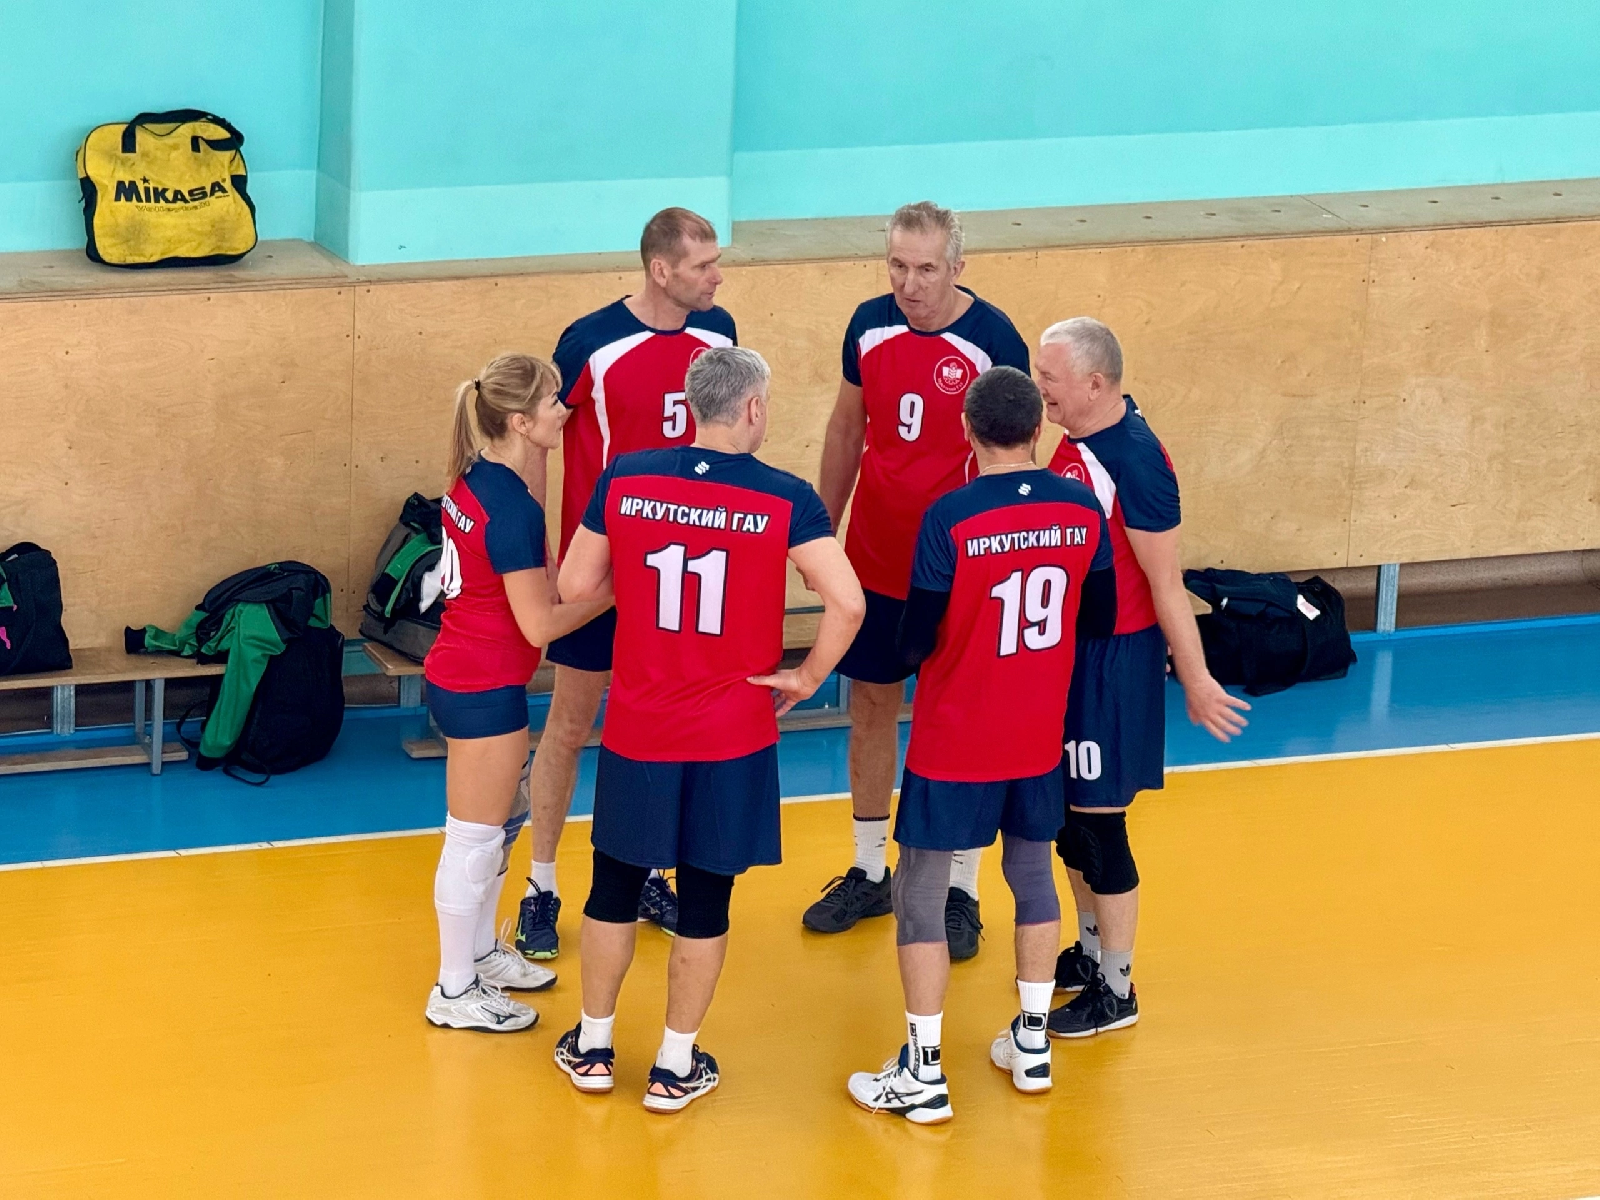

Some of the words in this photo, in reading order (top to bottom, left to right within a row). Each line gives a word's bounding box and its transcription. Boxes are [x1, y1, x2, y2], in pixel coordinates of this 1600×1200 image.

[662, 390, 688, 439] 5
[898, 392, 924, 443] 9
[455, 511, 475, 534] ГАУ
[619, 496, 727, 530] ИРКУТСКИЙ
[731, 512, 770, 534] ГАУ
[966, 525, 1062, 558] ИРКУТСКИЙ
[1065, 526, 1088, 546] ГАУ
[644, 541, 730, 637] 11
[989, 564, 1070, 658] 19
[1064, 740, 1102, 781] 10
